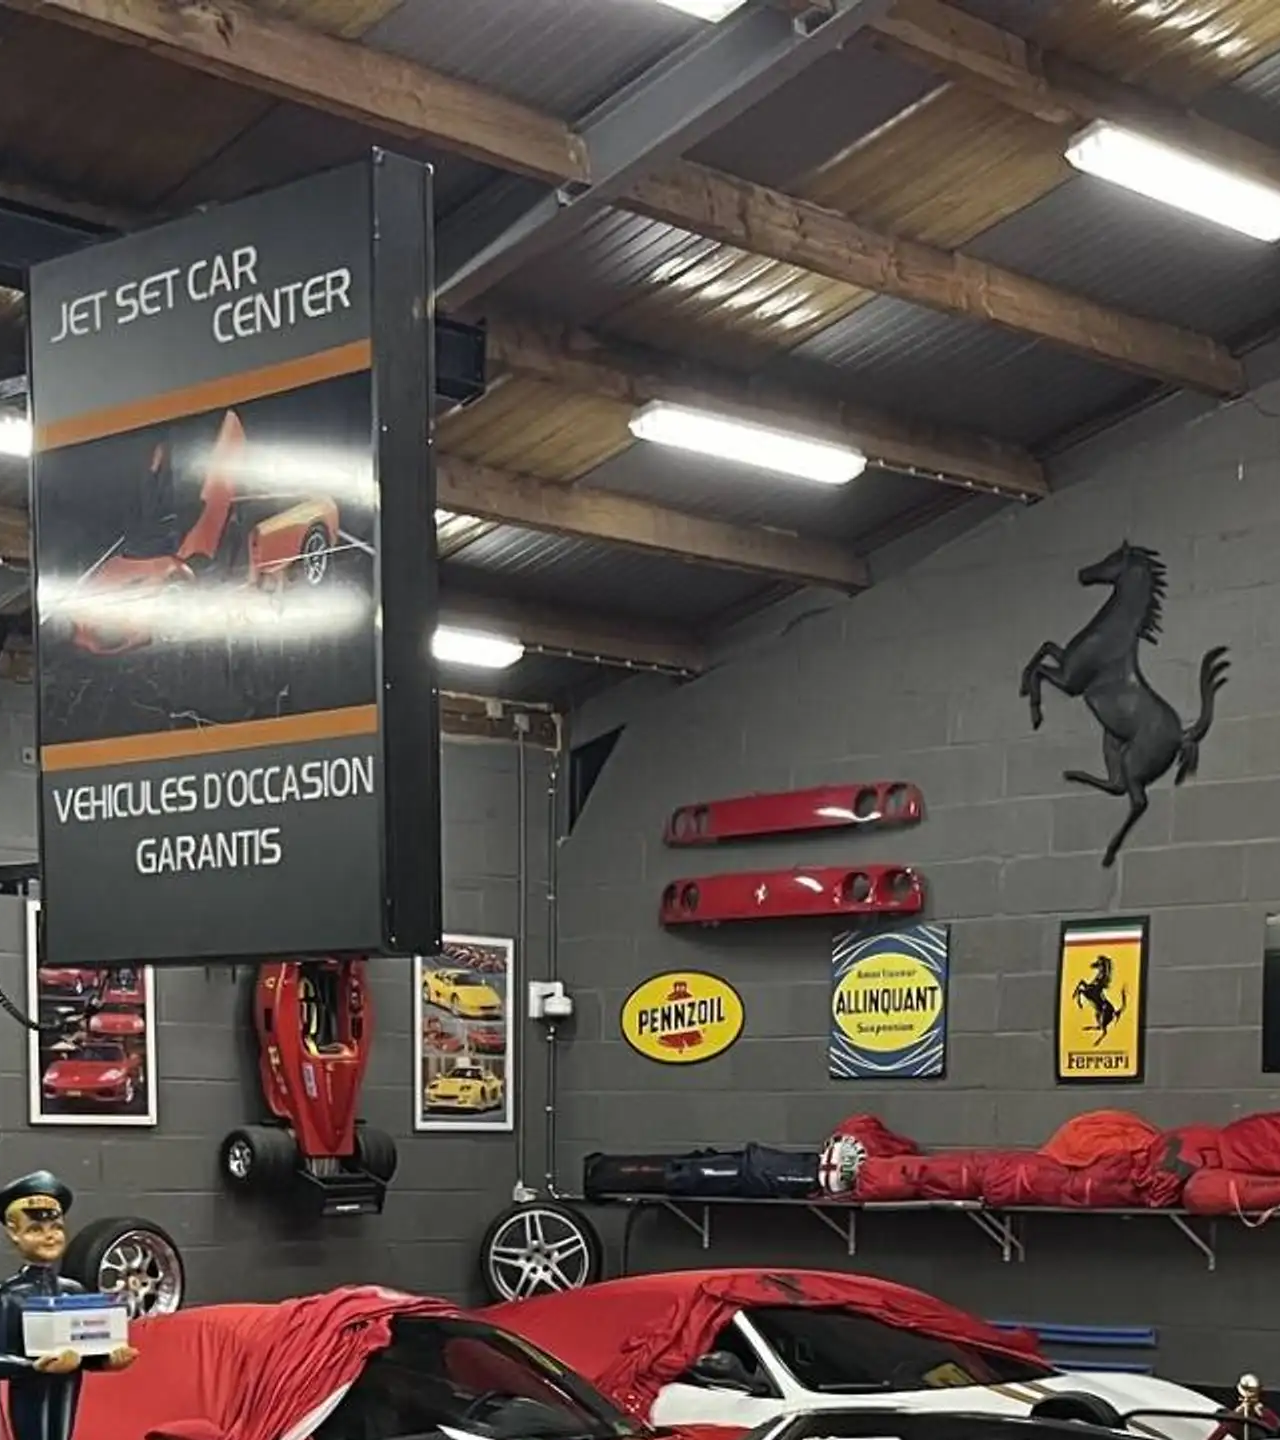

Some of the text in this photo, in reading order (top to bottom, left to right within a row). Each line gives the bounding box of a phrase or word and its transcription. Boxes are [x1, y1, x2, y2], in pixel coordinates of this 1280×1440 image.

[50, 245, 258, 343] JET SET CAR
[212, 267, 351, 343] CENTER
[52, 755, 374, 824] VEHICULES D'OCCASION
[136, 828, 282, 875] GARANTIS
[638, 996, 725, 1036] PENNZOIL
[836, 985, 939, 1018] ALLINQUANT
[1067, 1051, 1130, 1070] Ferrari
